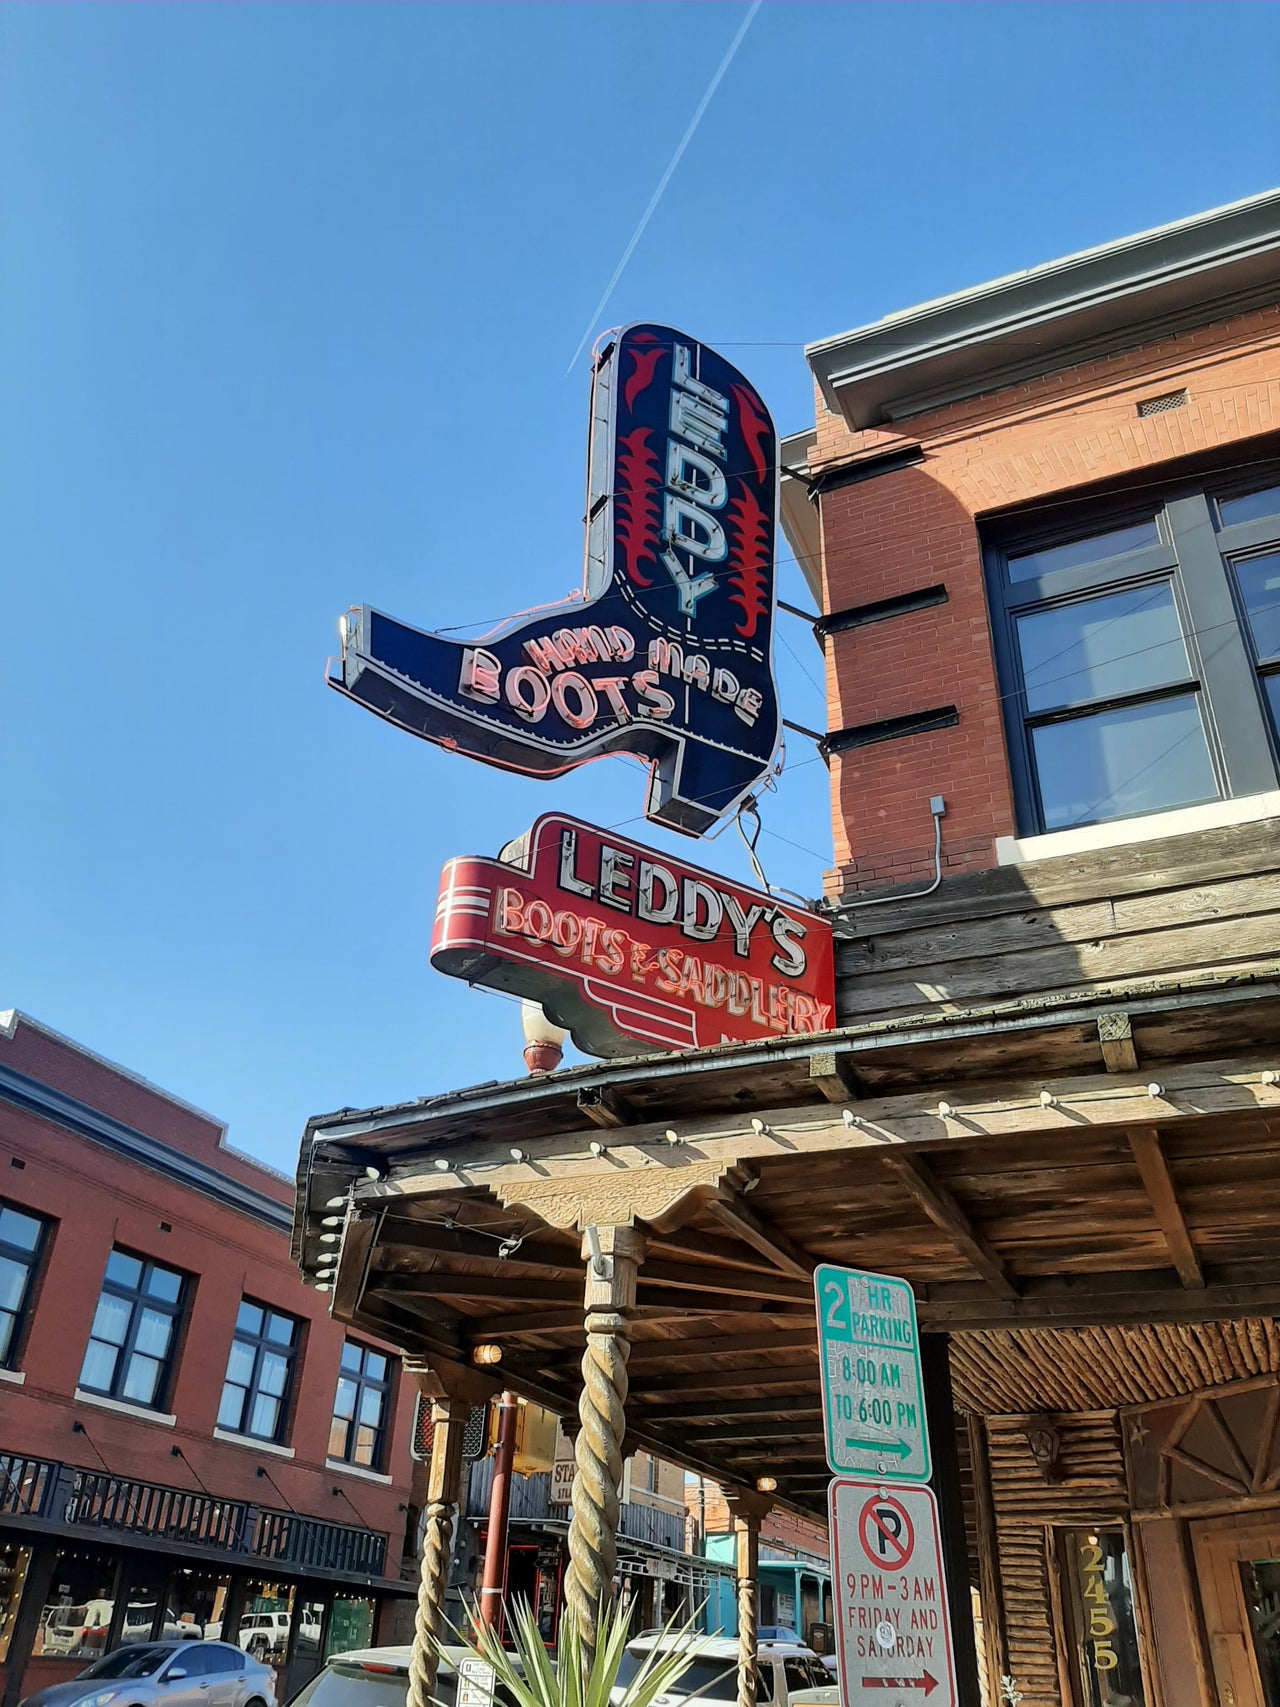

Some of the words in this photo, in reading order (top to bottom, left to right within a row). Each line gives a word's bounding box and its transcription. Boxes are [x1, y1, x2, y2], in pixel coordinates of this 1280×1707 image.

[660, 341, 730, 617] LEDDY
[458, 648, 675, 729] BOOTS
[523, 625, 635, 676] HAND
[649, 637, 763, 727] MADE
[557, 828, 808, 978] LEDDY'S
[492, 885, 630, 976] BOOTS
[653, 946, 832, 1034] SADDLERY
[824, 1281, 847, 1329] 2
[867, 1286, 893, 1311] HR
[852, 1311, 912, 1344] PARKING
[842, 1356, 877, 1385] 8:00
[880, 1362, 901, 1388] AM
[834, 1393, 851, 1420] TO
[858, 1398, 892, 1425] 6:00
[896, 1402, 917, 1428] PM
[555, 1464, 575, 1483] STA
[557, 1488, 572, 1499] STE
[850, 1607, 900, 1630] FRIDAY
[910, 1608, 938, 1630] AND
[1080, 1544, 1118, 1671] 2455
